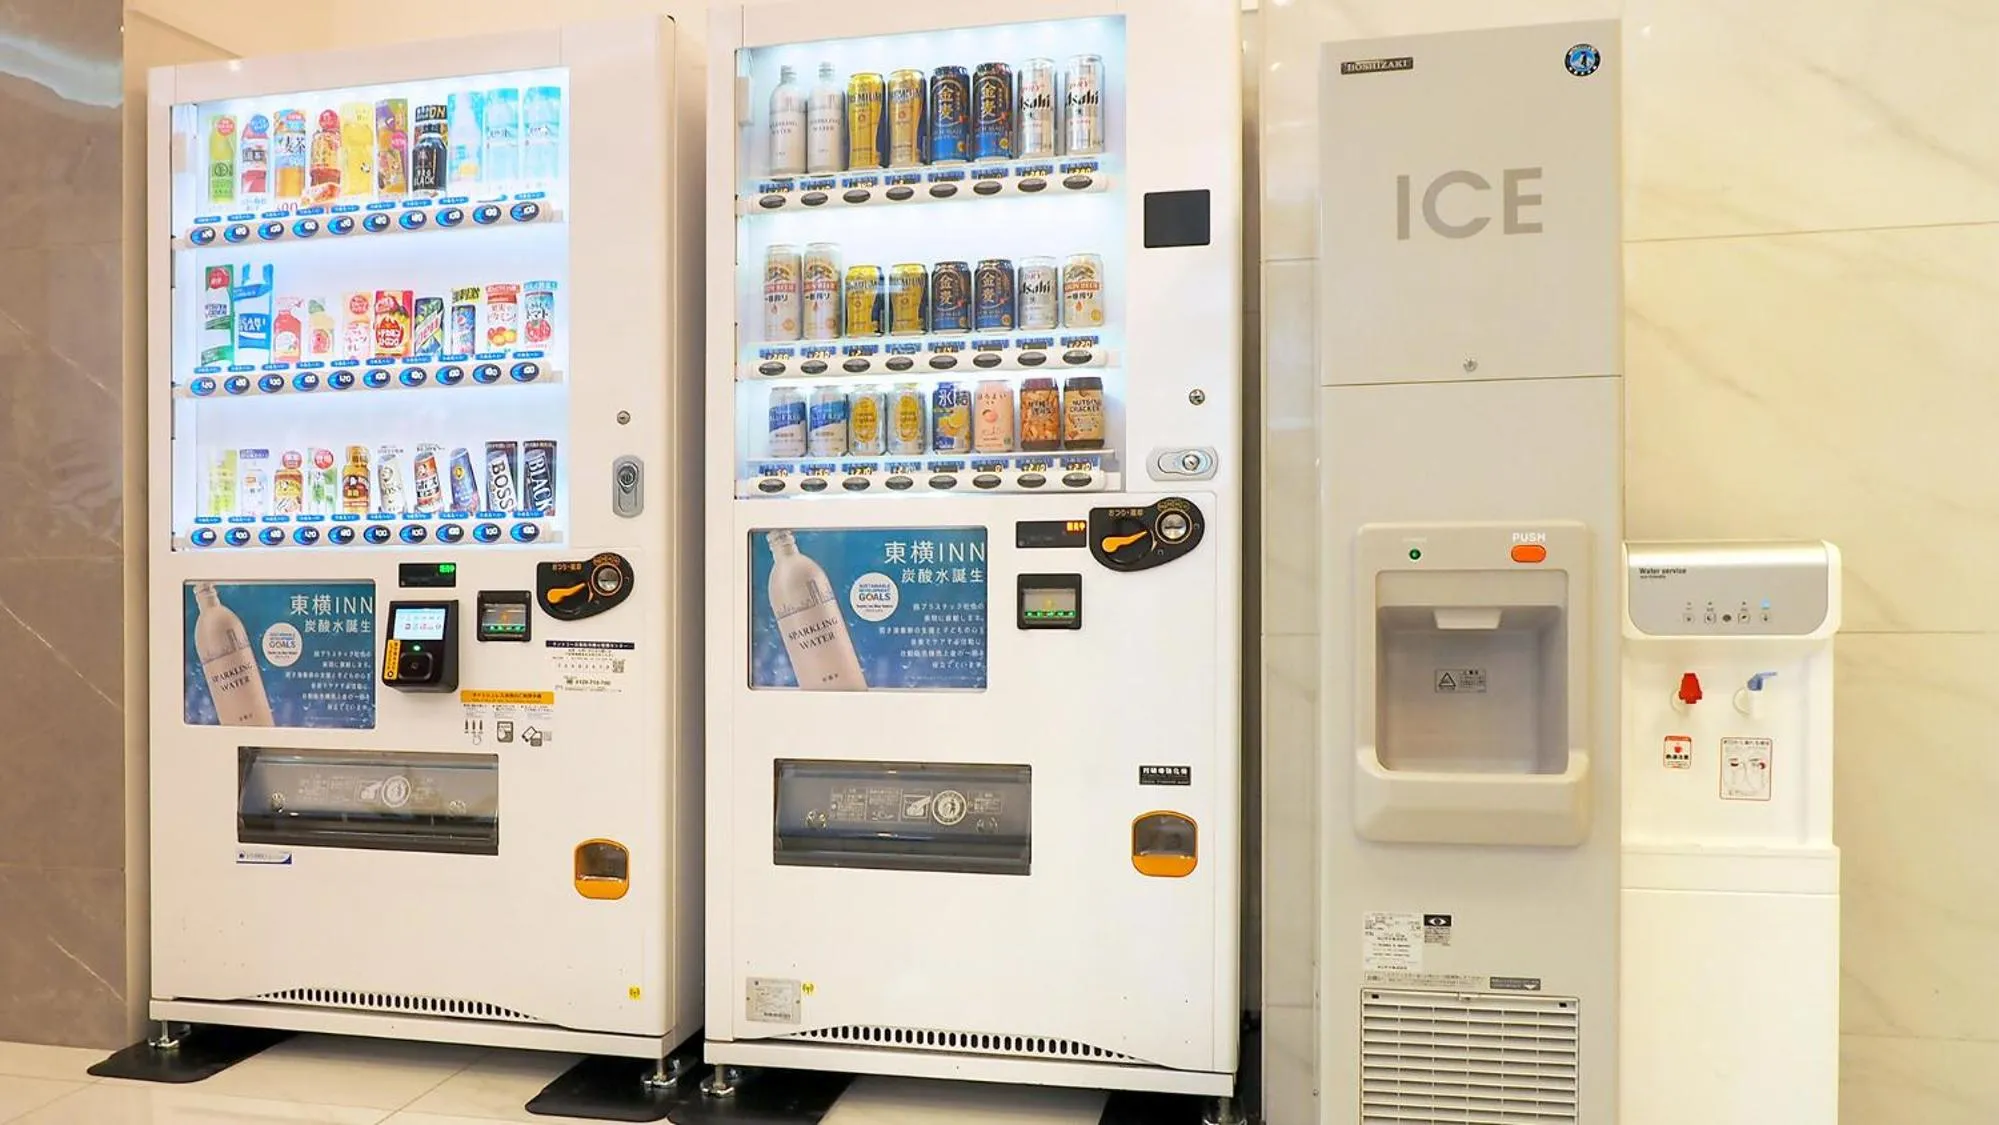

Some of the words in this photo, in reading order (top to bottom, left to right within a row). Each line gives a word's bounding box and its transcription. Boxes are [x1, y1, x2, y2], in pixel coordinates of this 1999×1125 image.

[1346, 59, 1407, 72] HOSHIZAKI
[938, 84, 954, 121] 金麦
[981, 81, 997, 117] 金麦
[1019, 94, 1051, 111] Asahi
[1065, 89, 1099, 107] Asahi
[1396, 167, 1543, 240] ICE
[939, 273, 953, 306] 金麦
[981, 271, 996, 303] 金麦
[1020, 280, 1051, 296] Asahi
[491, 460, 514, 510] BOSS
[528, 455, 553, 511] BLACK
[1512, 532, 1546, 543] PUSH
[884, 541, 985, 564] 東横INN
[901, 568, 984, 584] 炭酸水誕生
[290, 594, 373, 616] 東横INN
[859, 593, 891, 602] GOALS
[304, 619, 371, 633] 炭酸水誕生
[787, 616, 839, 642] SPARKLING
[269, 641, 296, 649] GOALS
[799, 632, 836, 651] WATER
[211, 663, 253, 683] SPARKLING
[221, 675, 250, 692] WATER
